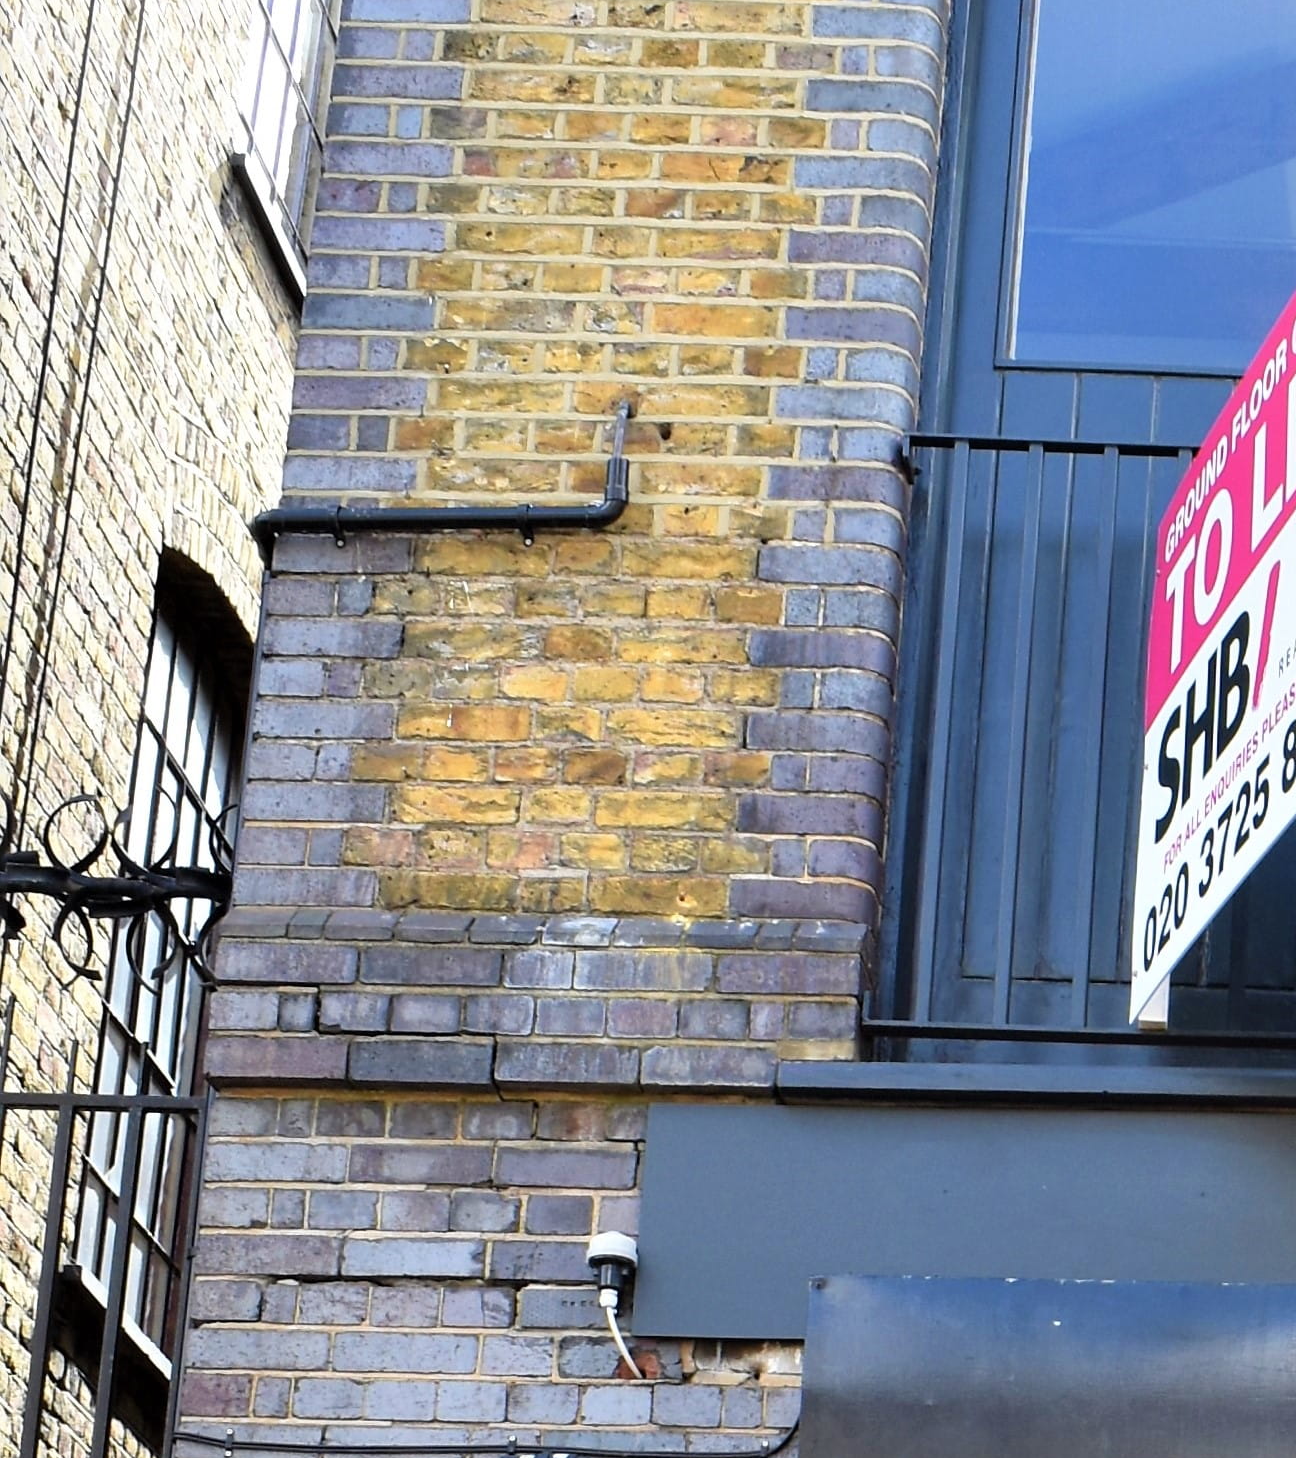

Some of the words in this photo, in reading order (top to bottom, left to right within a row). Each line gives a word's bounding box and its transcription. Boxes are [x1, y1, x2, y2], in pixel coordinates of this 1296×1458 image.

[1165, 434, 1227, 563] GROUND
[1232, 338, 1287, 454] FLOOR
[1165, 487, 1234, 675] TO
[1154, 610, 1251, 845] SHB
[1163, 834, 1183, 874] FOR
[1184, 808, 1202, 842] ALL
[1204, 732, 1260, 818] ENQUIRIES
[1143, 861, 1190, 973] 020
[1198, 752, 1271, 898] 3725
